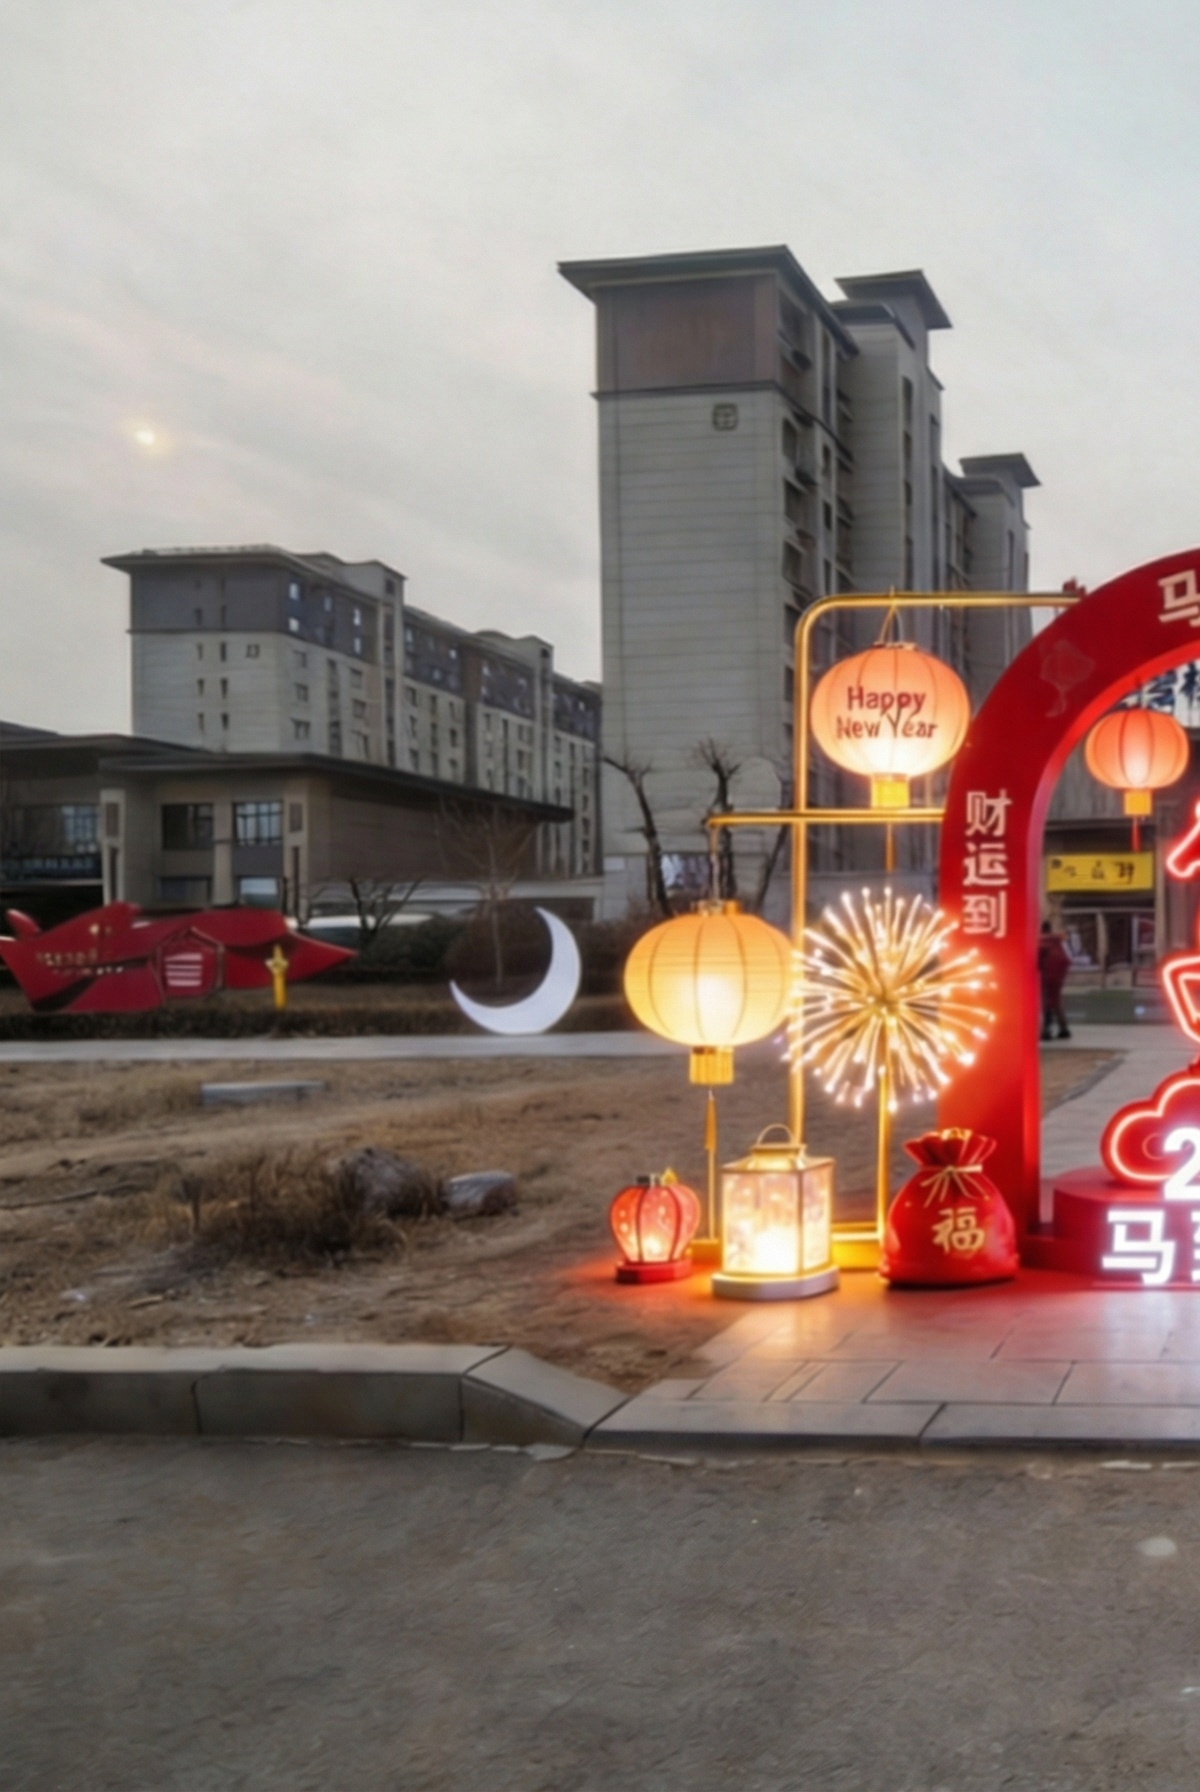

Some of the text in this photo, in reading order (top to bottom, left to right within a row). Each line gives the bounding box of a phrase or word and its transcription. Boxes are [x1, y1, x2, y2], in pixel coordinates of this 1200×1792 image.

[847, 686, 926, 718] Happy
[837, 711, 938, 739] New Year
[962, 789, 1013, 938] 财运到
[932, 1207, 985, 1255] 福
